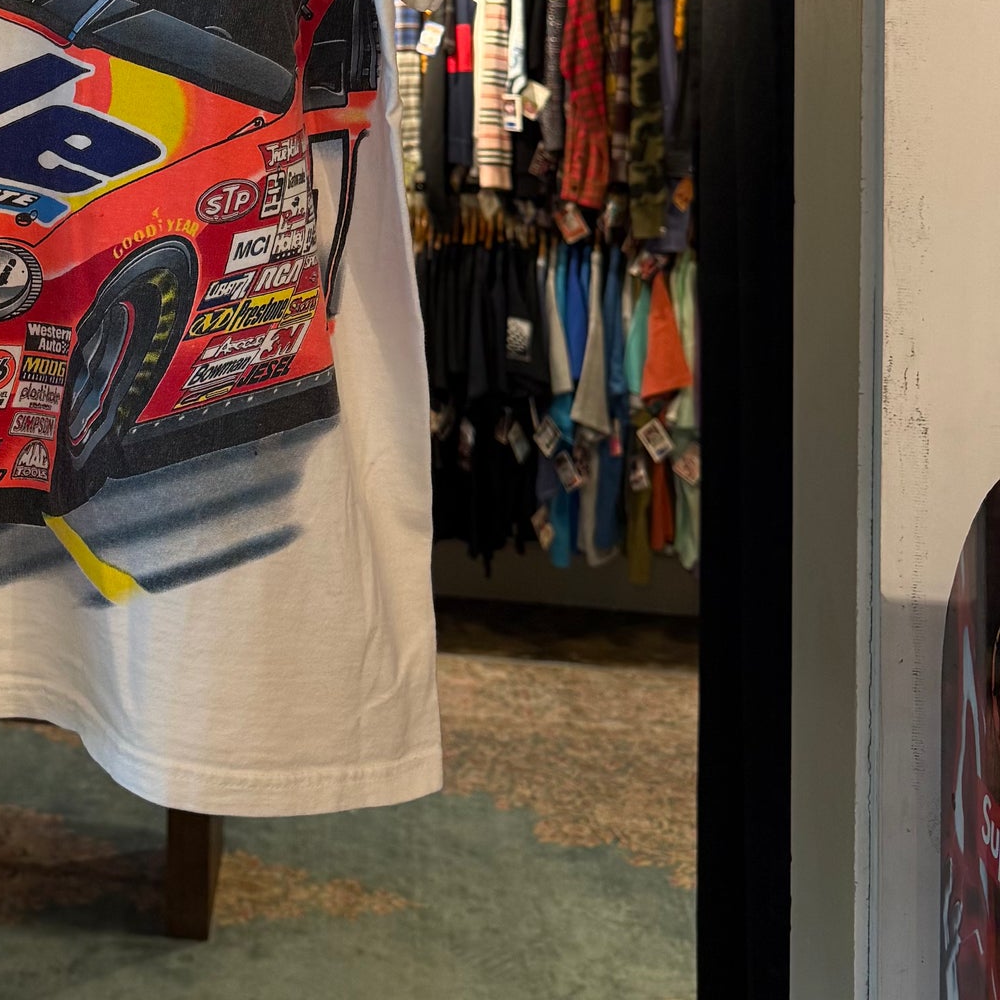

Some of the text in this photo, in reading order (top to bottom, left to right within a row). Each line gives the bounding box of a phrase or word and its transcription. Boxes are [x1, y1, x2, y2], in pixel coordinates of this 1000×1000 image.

[205, 184, 251, 216] STP
[233, 235, 272, 260] MCI
[234, 298, 291, 330] Prestone
[27, 323, 72, 340] Western
[38, 337, 62, 353] Auto
[22, 356, 67, 378] MOOG
[187, 356, 252, 387] Bowman
[13, 414, 54, 434] SIMPSON
[17, 442, 50, 469] MAC
[14, 466, 49, 480] TOOLS
